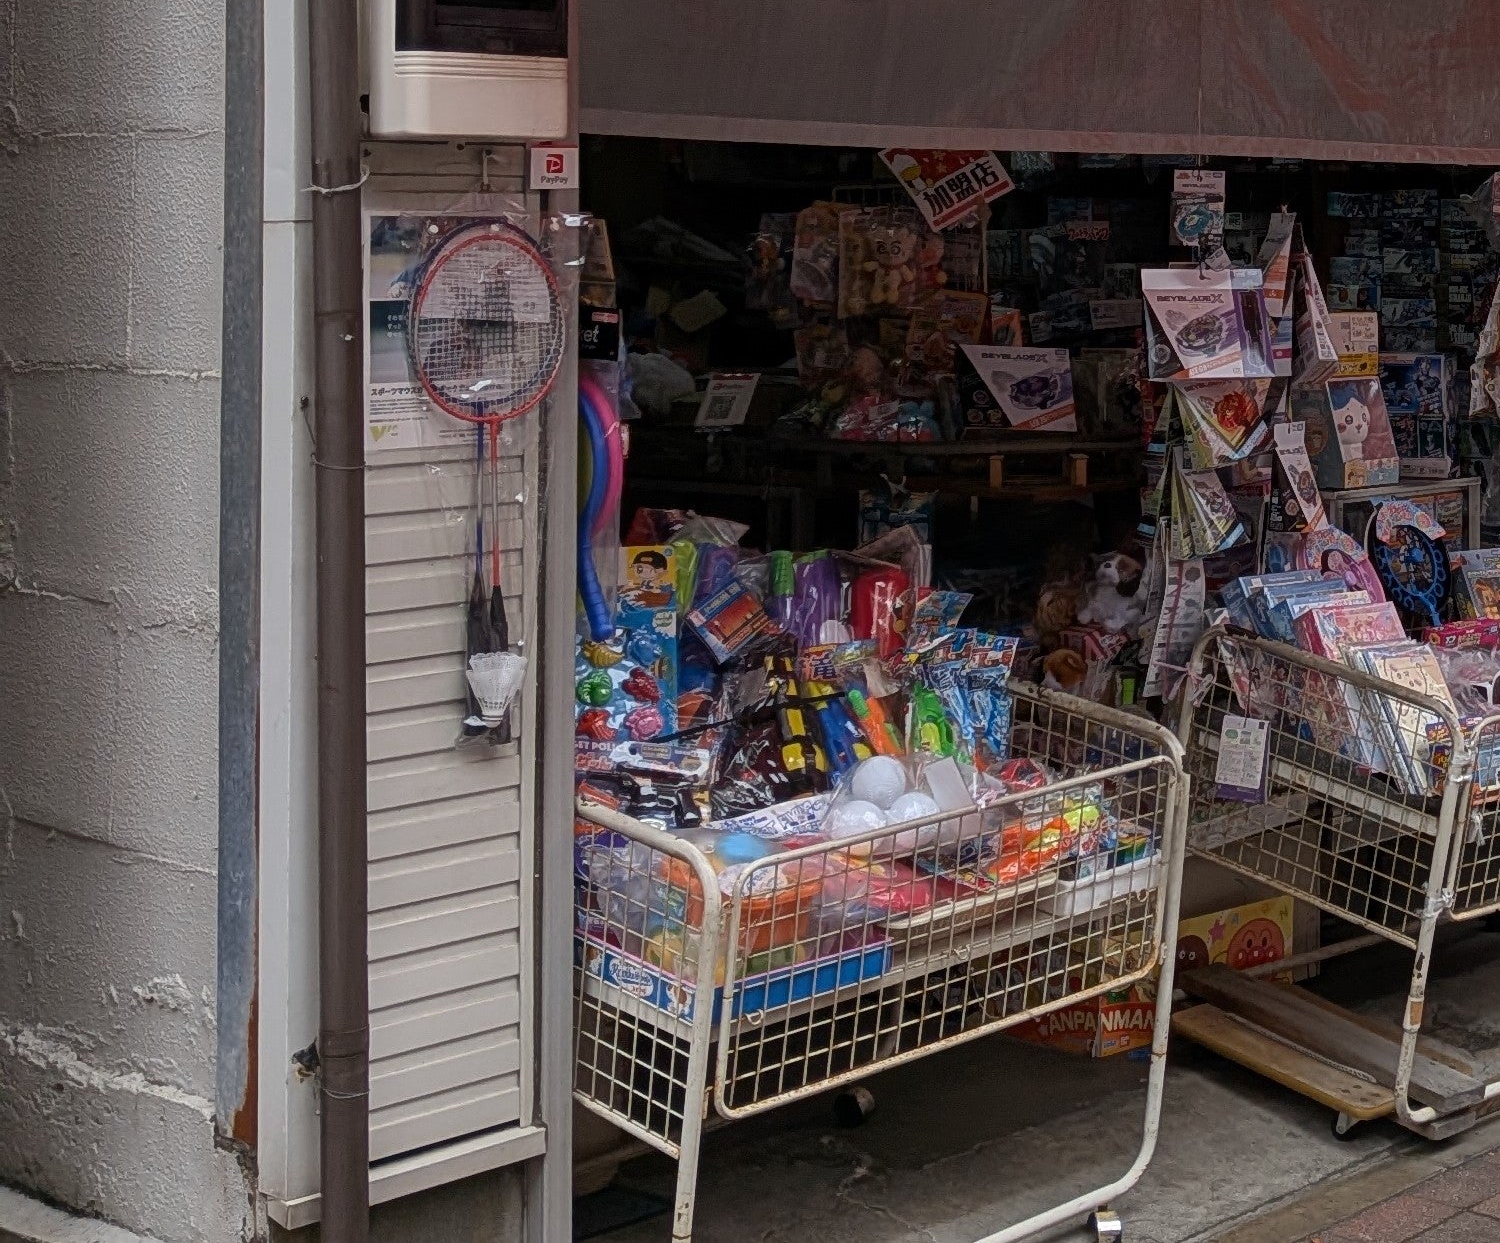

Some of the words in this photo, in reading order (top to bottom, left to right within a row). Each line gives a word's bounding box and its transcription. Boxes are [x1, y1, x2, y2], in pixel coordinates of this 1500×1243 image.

[540, 174, 568, 185] PayPay
[923, 159, 1000, 217] 加盟店
